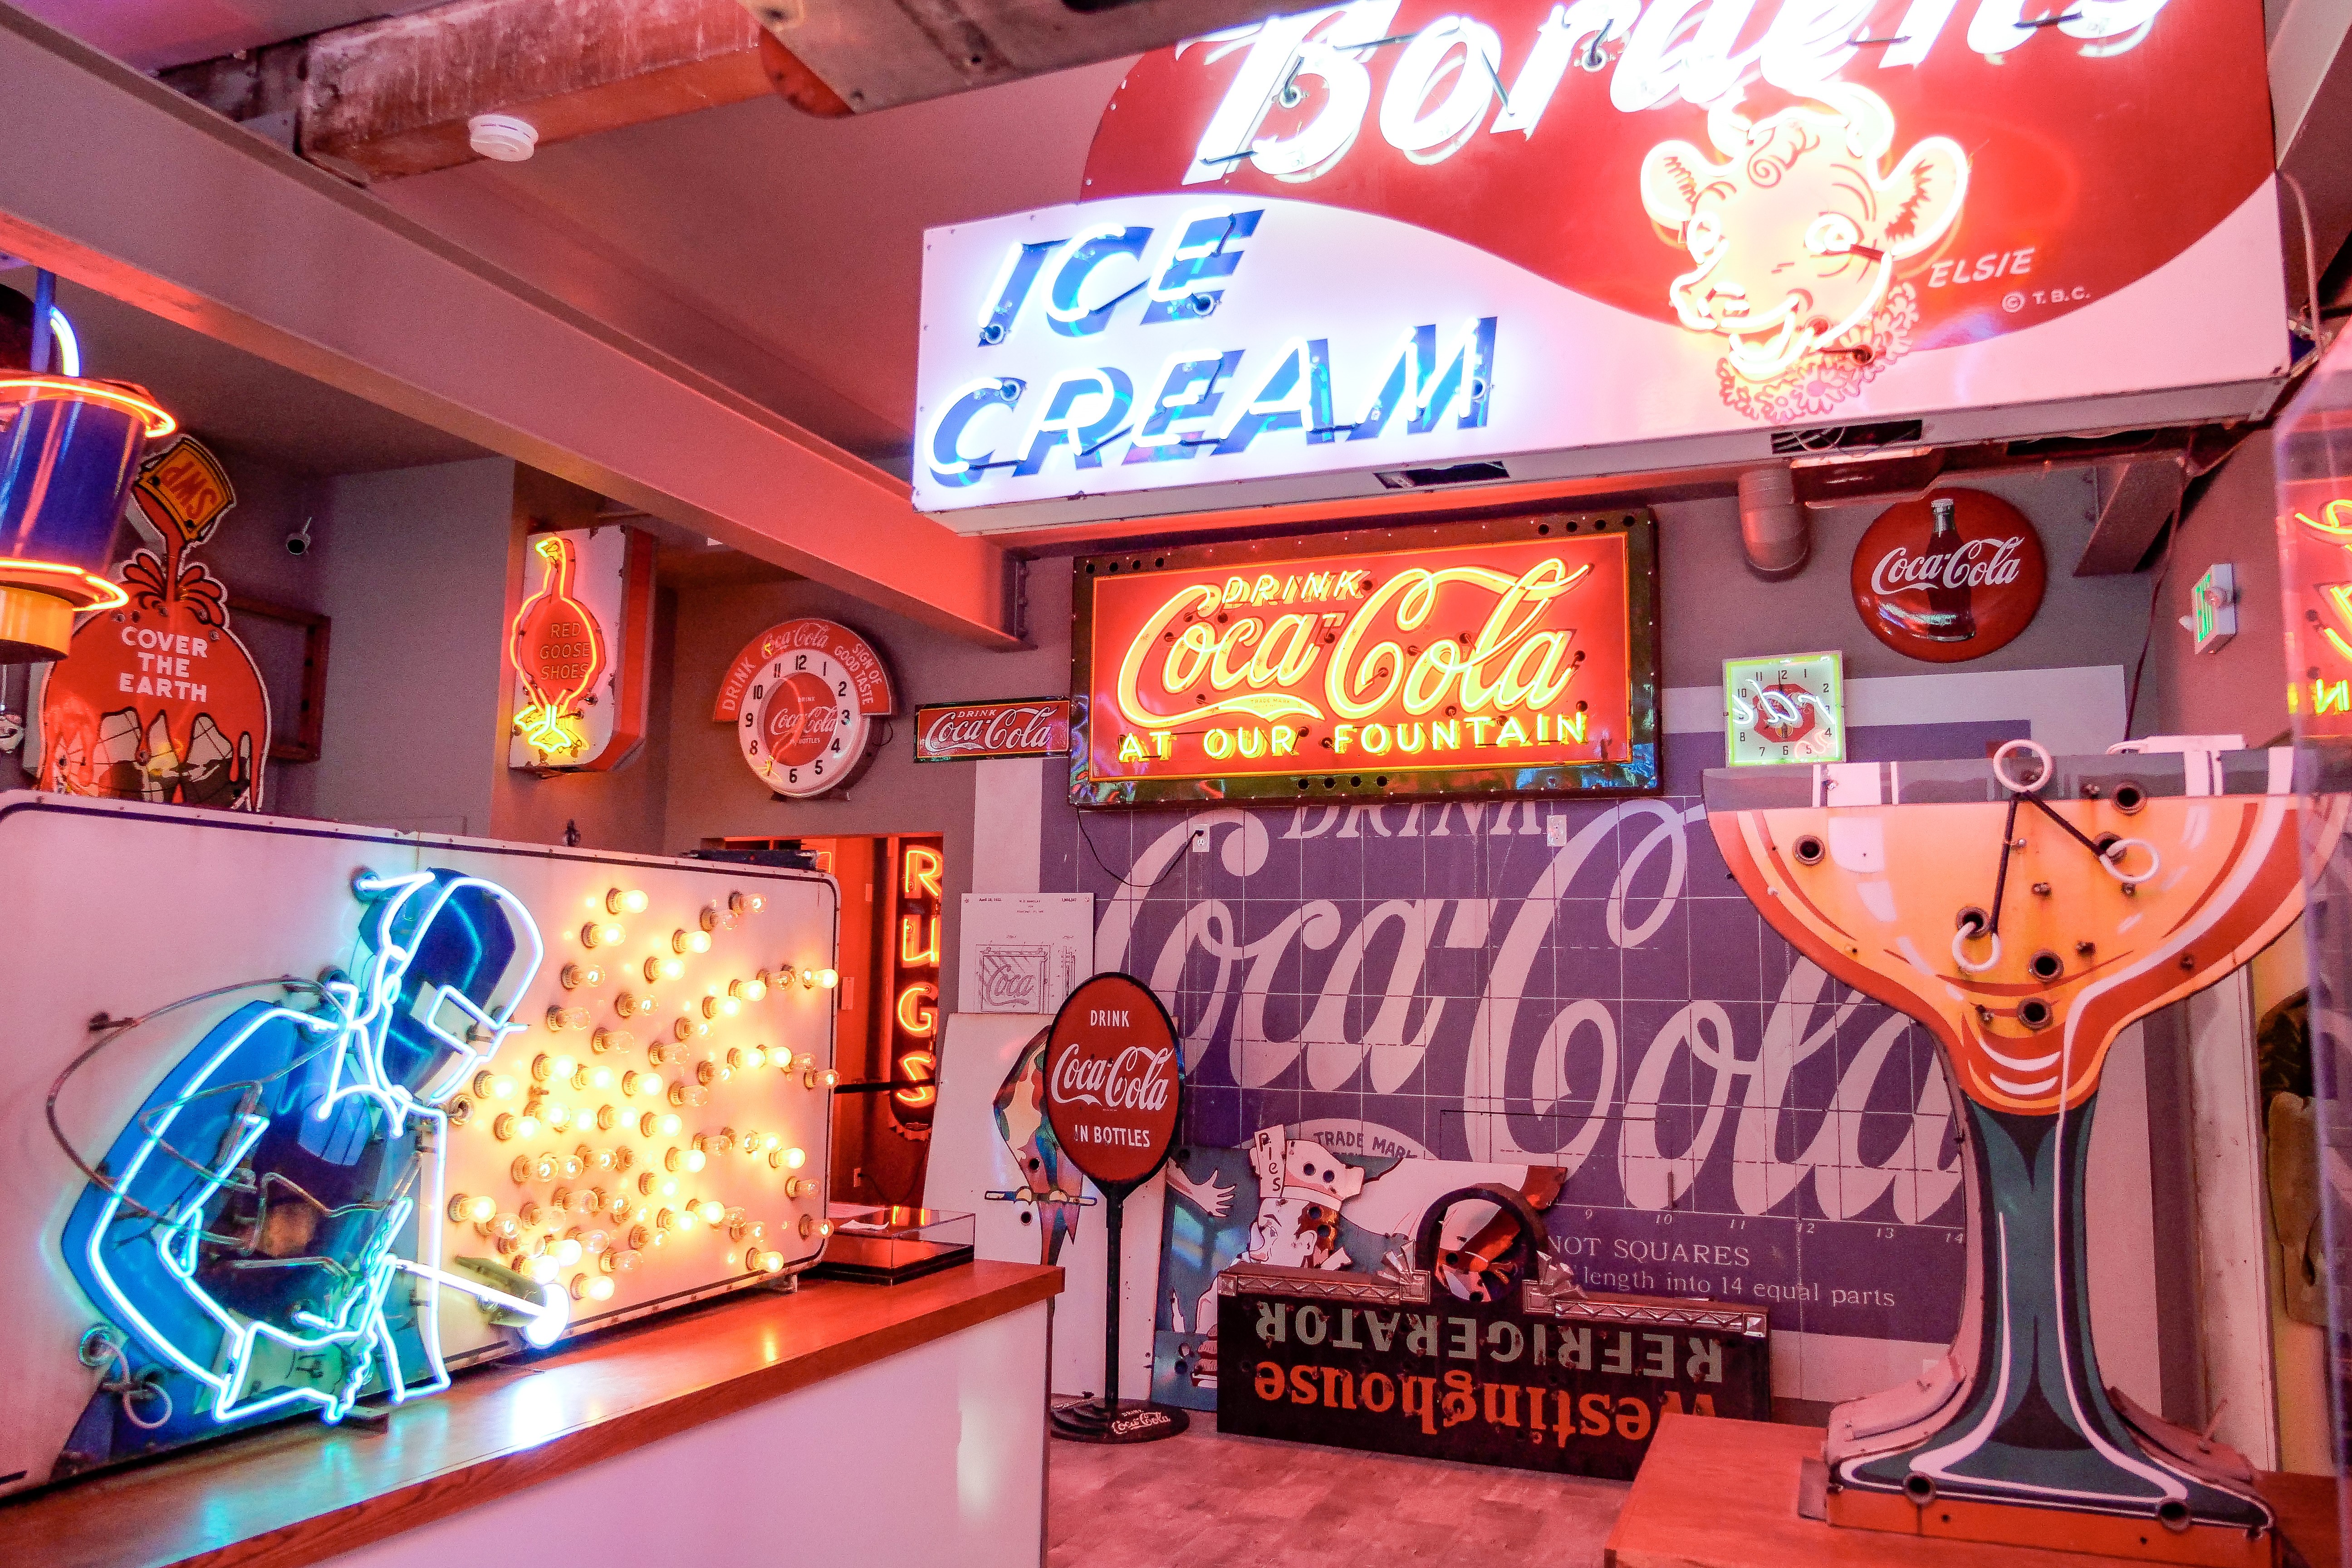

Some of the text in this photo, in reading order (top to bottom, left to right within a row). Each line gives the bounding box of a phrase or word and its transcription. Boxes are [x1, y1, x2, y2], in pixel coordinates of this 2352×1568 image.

[1175, 0, 2178, 186] Borden
[977, 206, 1265, 348] ICE
[1927, 246, 2036, 288] ELSIE
[925, 316, 1498, 488] CREAM
[162, 461, 220, 519] SWP
[1871, 536, 2025, 595] Coca-Cola
[1214, 567, 1368, 609] DRINK
[549, 622, 581, 638] RED
[121, 626, 208, 659] COVER
[540, 643, 591, 661] GOOSE
[1117, 556, 1595, 730] Coca-Cola
[137, 652, 190, 679] THE
[540, 664, 591, 681] SHOES
[721, 622, 831, 711] DRINK Coca-Cola
[774, 662, 781, 678] 11
[795, 654, 808, 671] 12
[823, 661, 827, 676] 1
[852, 643, 882, 685] SIGN OF
[834, 645, 874, 706] GOOD TASTE
[1755, 671, 1763, 681] 11
[118, 673, 208, 703] EARTH
[753, 684, 764, 700] 10
[838, 681, 848, 697] 2
[1737, 688, 1747, 698] 10
[1823, 683, 1829, 693] 2
[745, 712, 754, 728] 9
[841, 709, 851, 725] 3
[957, 709, 997, 718] DRINK
[925, 705, 1059, 753] Coca-Cola
[1118, 711, 1589, 763] AT OUR FOUNTAIN
[1740, 731, 1746, 742] 8
[1824, 727, 1832, 737] 4
[750, 740, 759, 755] 8
[831, 738, 840, 753] 4
[1759, 747, 1765, 757] 7
[1783, 745, 1789, 755] 6
[789, 768, 798, 784] 6
[814, 760, 823, 775] 5
[897, 845, 943, 1108] RUGS
[1090, 1009, 1130, 1028] DRINK
[1093, 796, 1965, 1225] Coca-Cola
[1051, 1044, 1174, 1111] Coca-Cola
[1074, 1124, 1150, 1148] IN BOTTLES
[1313, 1131, 1364, 1148] TRADE
[1257, 1132, 1282, 1192] Pies
[1585, 1209, 1964, 1244] 9 10 11 12 13 14
[1548, 1235, 1751, 1267] NOT SQUARES
[1583, 1265, 1896, 1308] length into 14 equal parts
[1256, 1301, 1723, 1383] REFRIGERATOR
